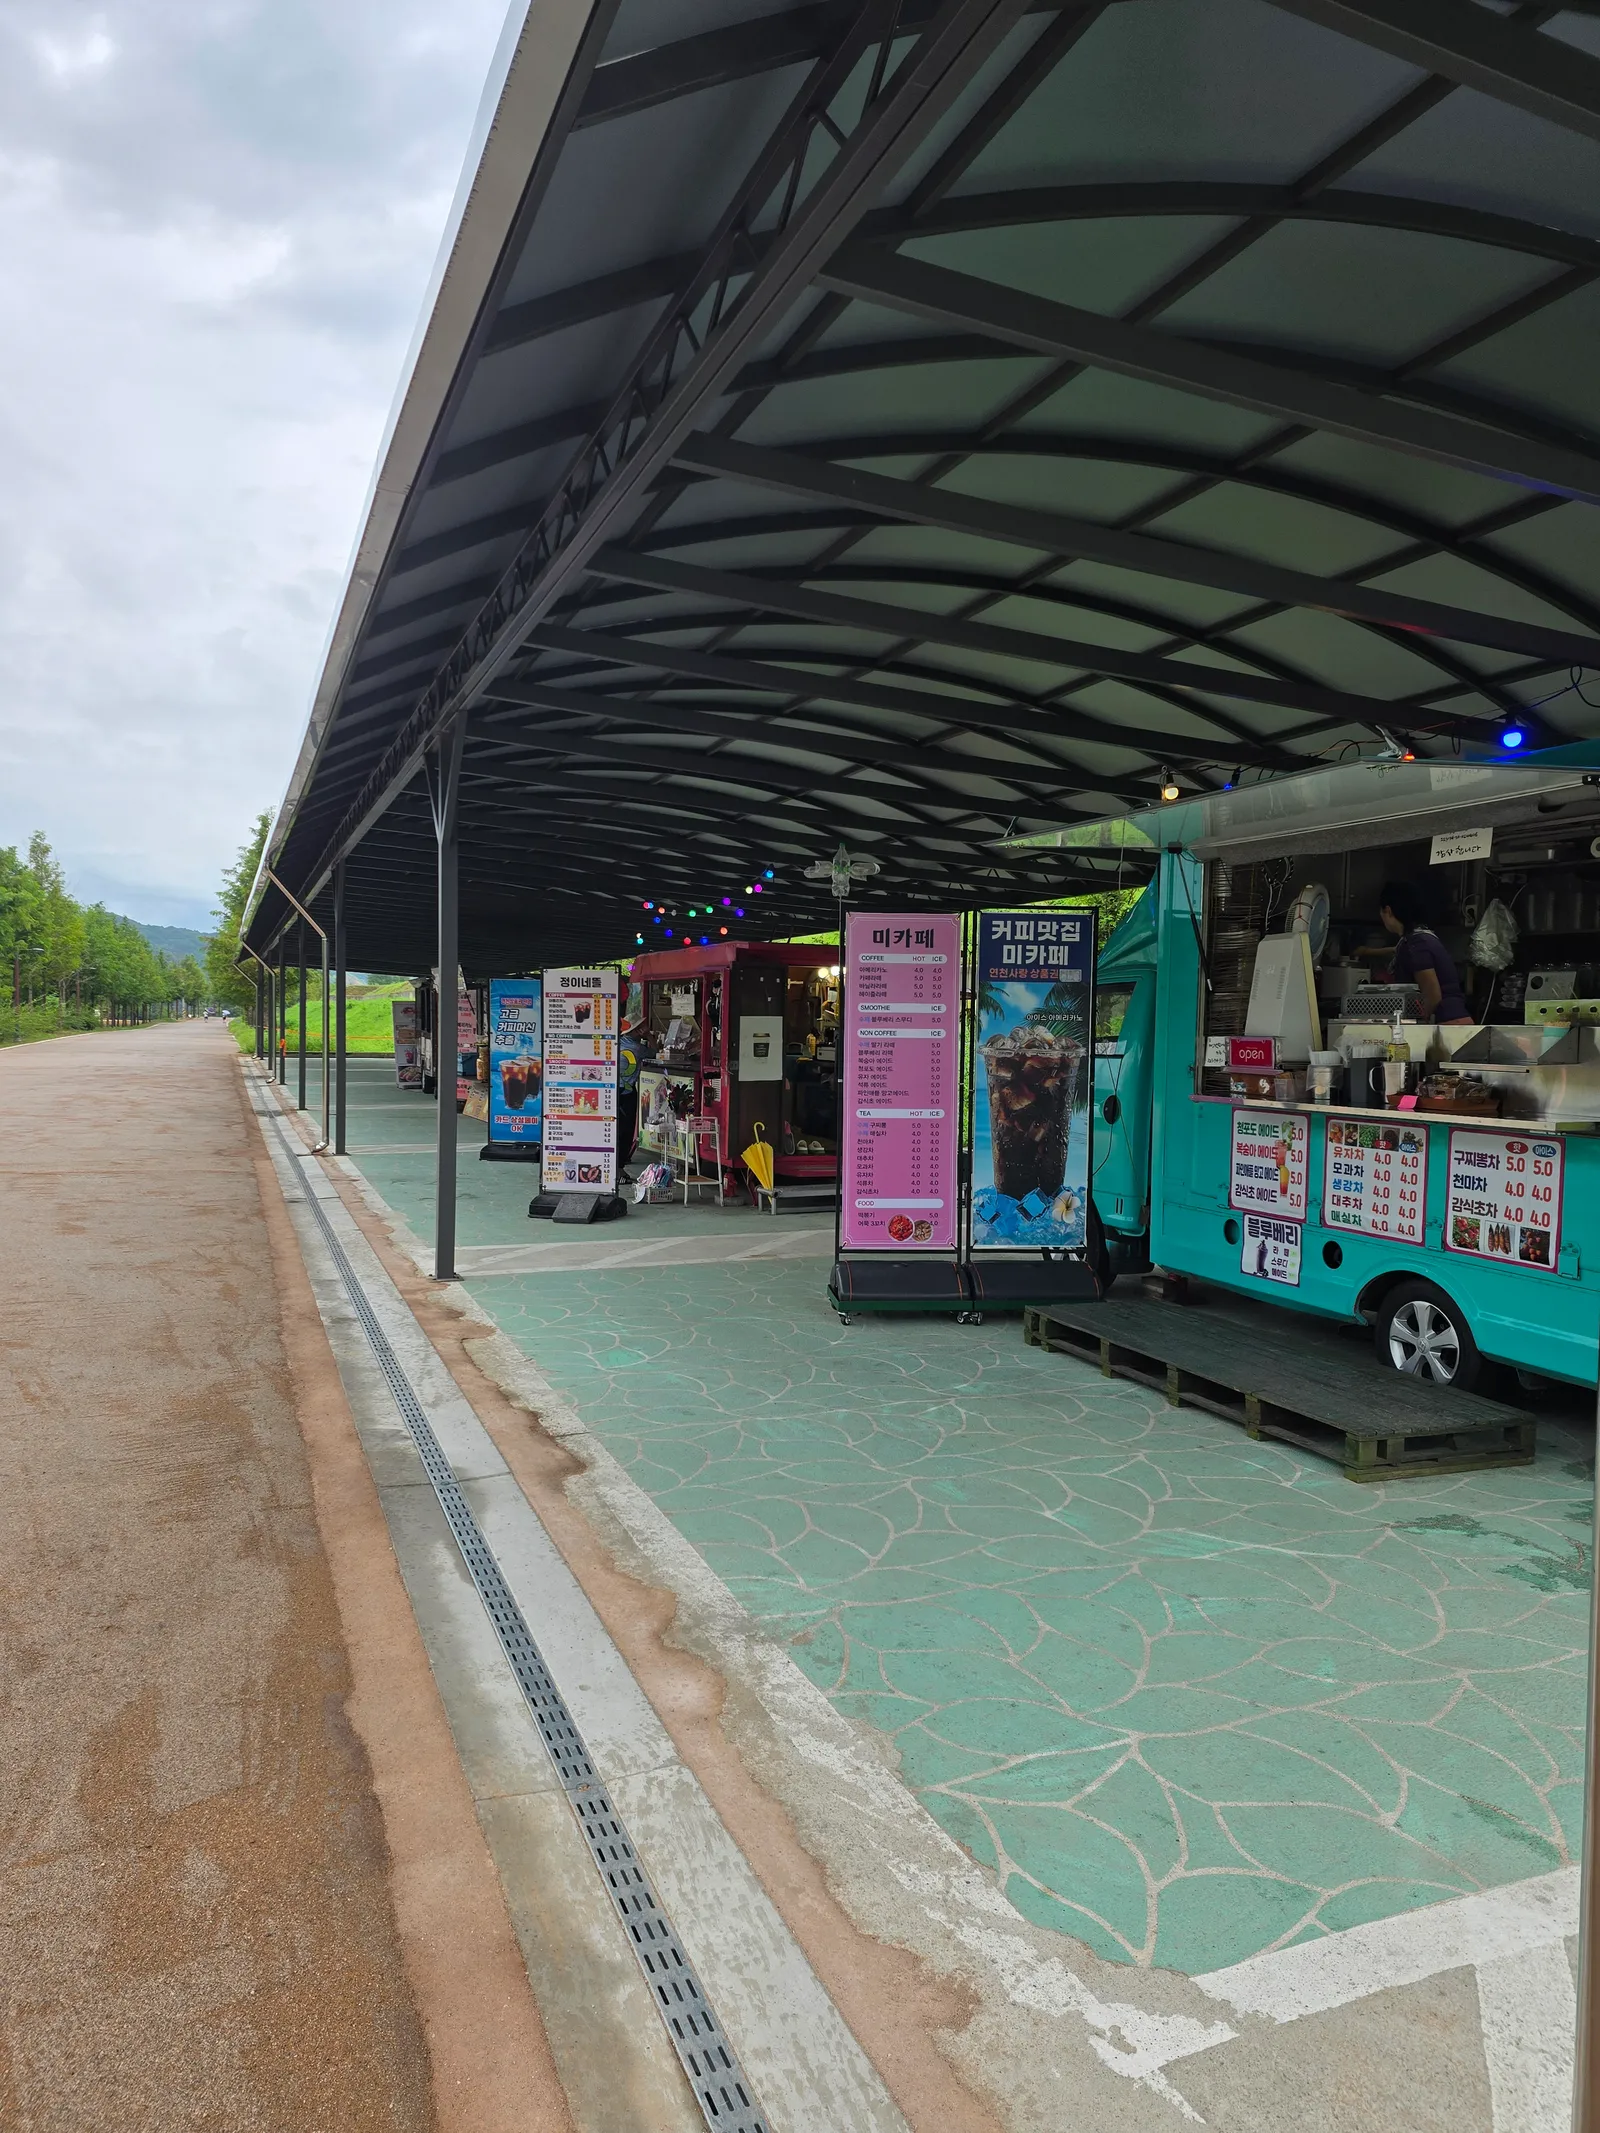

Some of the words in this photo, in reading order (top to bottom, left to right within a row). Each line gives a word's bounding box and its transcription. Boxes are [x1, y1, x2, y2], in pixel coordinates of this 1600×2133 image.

[873, 928, 934, 948] 미카페
[992, 920, 1080, 942] 커피맛집
[1002, 945, 1069, 966] 미카페
[560, 977, 602, 988] 정이네뜰
[990, 968, 1028, 979] 연천사랑
[1030, 968, 1059, 979] 상품권
[500, 1009, 520, 1020] 고급
[1049, 1014, 1083, 1022] 아메리카노
[498, 1022, 536, 1033] 커피머신
[1239, 1050, 1264, 1062] open
[496, 1116, 510, 1124] 카드
[1237, 1122, 1257, 1136] 청포도
[1258, 1124, 1280, 1138] 에이드
[1292, 1128, 1304, 1140] 5.0
[1236, 1142, 1256, 1158] 복숭아
[1258, 1145, 1279, 1160] 에이드
[1291, 1150, 1303, 1163] 5.0
[1380, 1141, 1386, 1149] 핫
[1402, 1144, 1417, 1152] 아이스
[1513, 1142, 1522, 1154] 핫
[1536, 1146, 1554, 1156] 아이스
[1334, 1146, 1364, 1161] 유자차
[1374, 1152, 1392, 1166] 4.0
[1401, 1155, 1418, 1168] 4.0
[1454, 1150, 1500, 1170] 구찌뽕차
[1506, 1156, 1526, 1172] 5.0
[1534, 1160, 1553, 1176] 5.0
[1264, 1166, 1279, 1182] 에이드
[1290, 1172, 1302, 1186] 5.0
[1333, 1162, 1364, 1178] 모과차
[1374, 1169, 1391, 1182] 4.0
[1400, 1172, 1418, 1186] 4.0
[1236, 1184, 1255, 1200] 감식초
[1256, 1188, 1278, 1204] 에이드
[1290, 1194, 1302, 1208] 5.0
[1332, 1178, 1364, 1194] 생강차
[1373, 1186, 1390, 1199] 4.0
[1400, 1189, 1418, 1203] 4.0
[1453, 1174, 1488, 1192] 천마차
[1505, 1181, 1525, 1198] 4.0
[1532, 1185, 1552, 1202] 4.0
[1332, 1194, 1363, 1210] 대추차
[1372, 1202, 1390, 1216] 4.0
[1399, 1206, 1416, 1220] 4.0
[1452, 1197, 1498, 1218] 감식초차
[1504, 1206, 1524, 1222] 4.0
[1530, 1210, 1551, 1228] 4.0
[1248, 1217, 1298, 1246] 블루베리
[1331, 1210, 1362, 1226] 매실차
[1372, 1219, 1388, 1232] 4.0
[1398, 1223, 1416, 1237] 4.0
[1271, 1257, 1288, 1268] 스무디
[1272, 1268, 1288, 1280] 에이드
